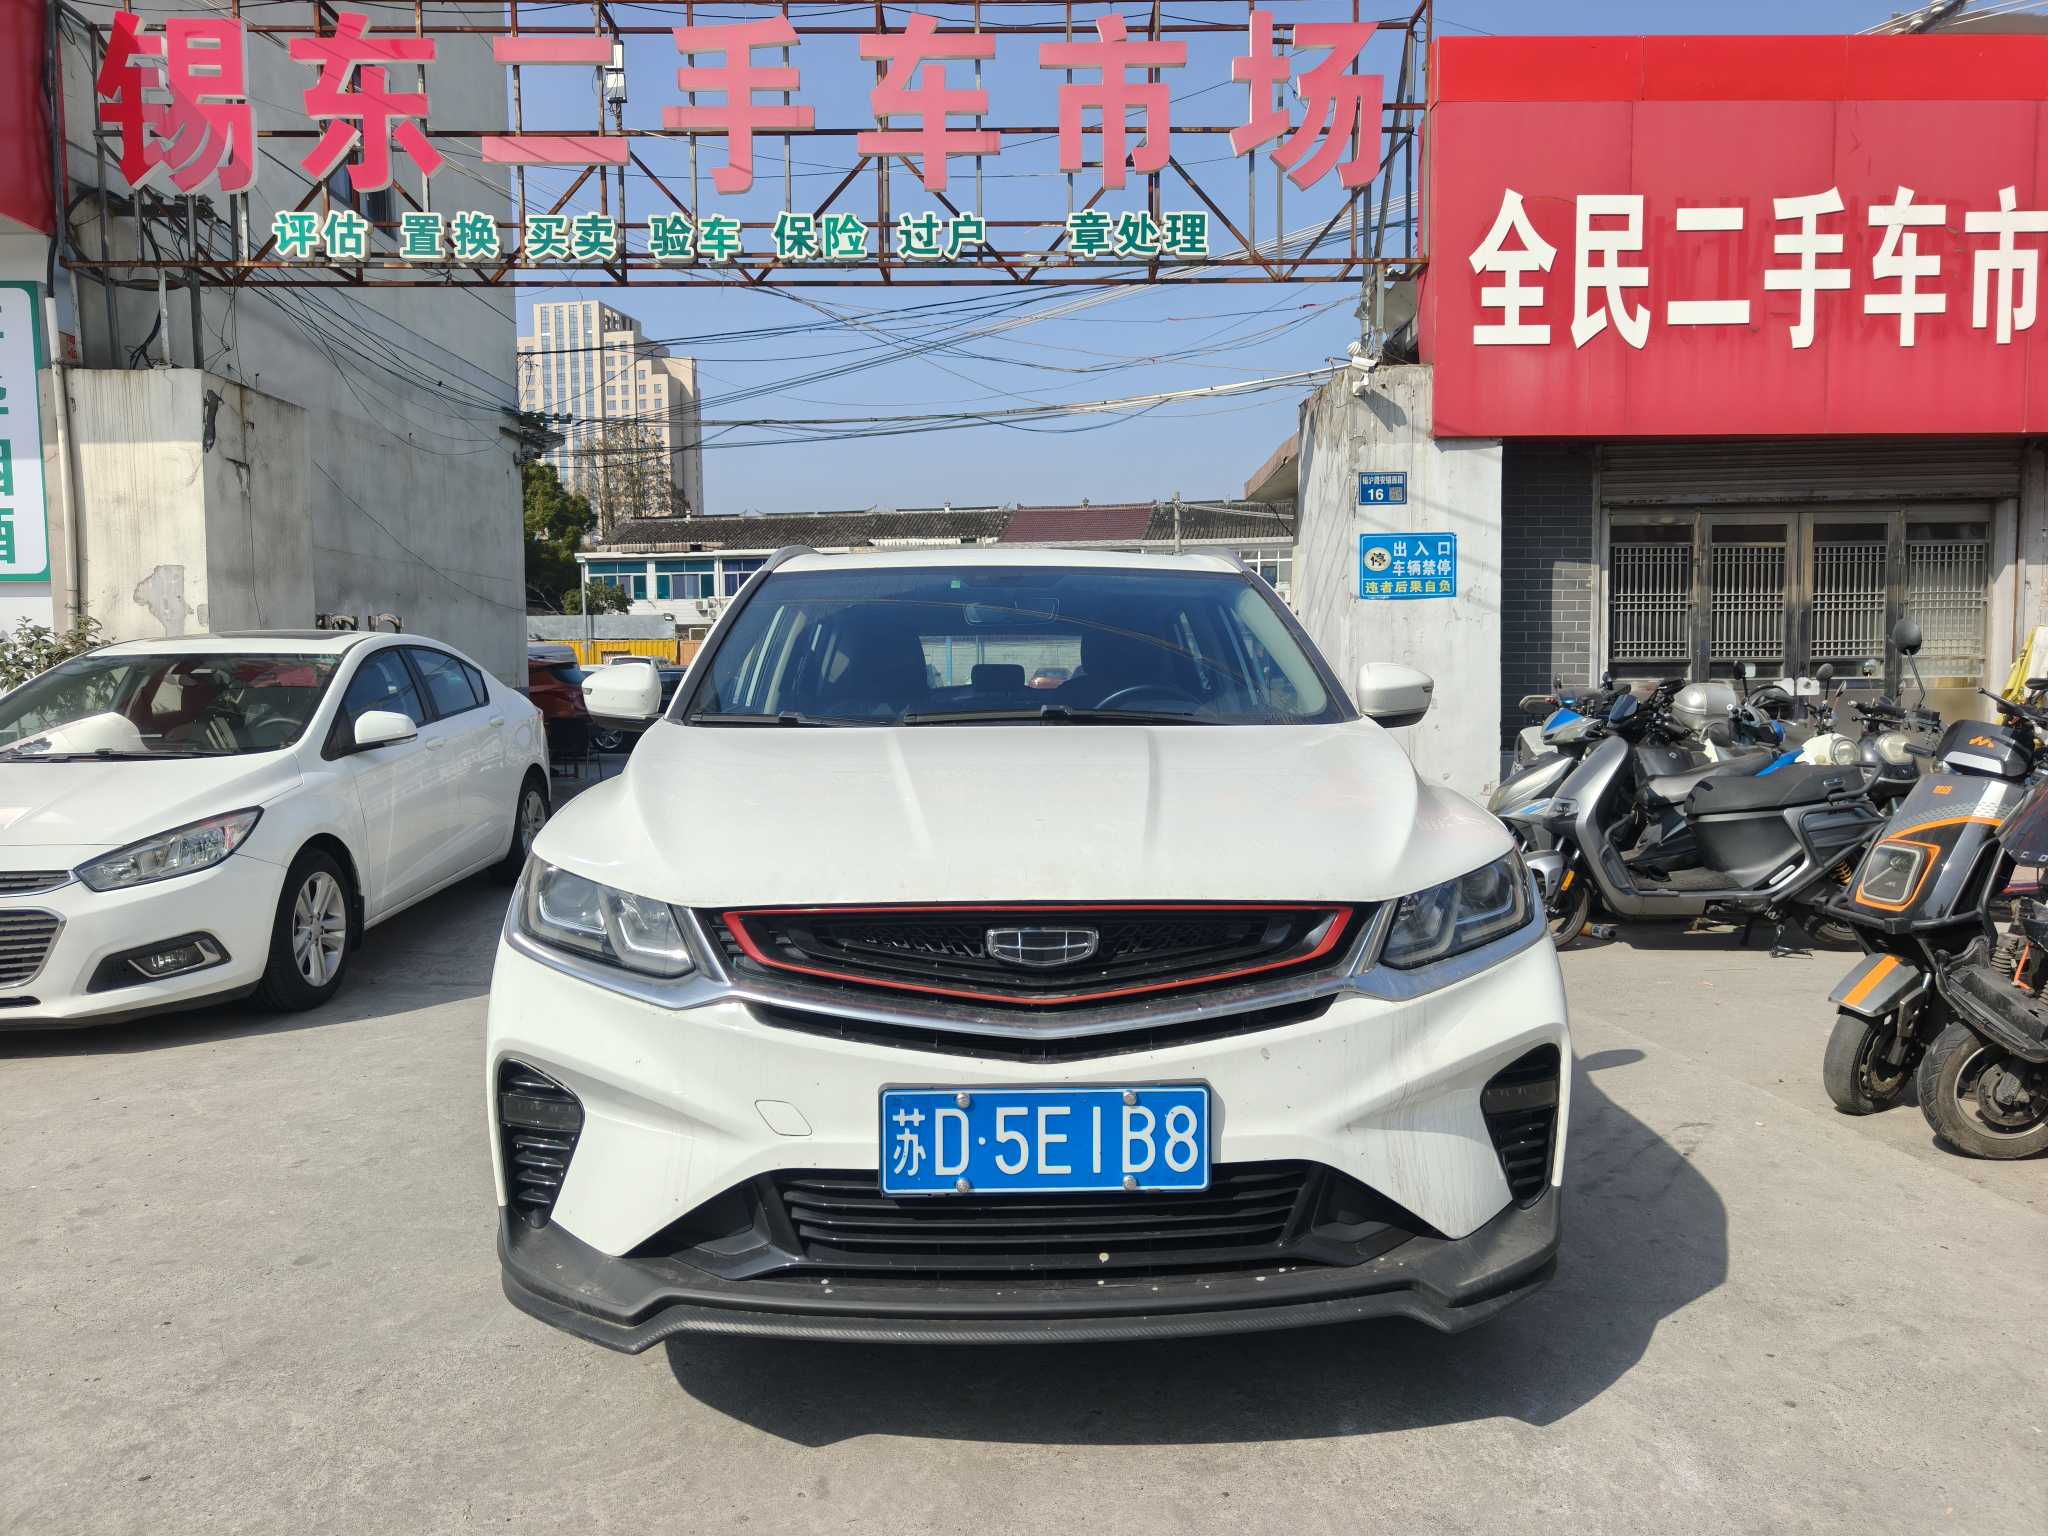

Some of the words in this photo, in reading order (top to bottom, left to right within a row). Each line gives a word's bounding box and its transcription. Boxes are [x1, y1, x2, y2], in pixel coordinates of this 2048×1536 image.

[97, 11, 1385, 193] 锡东二手车市场
[273, 212, 366, 257] 评估
[402, 213, 498, 258] 置换
[527, 213, 614, 258] 买卖
[648, 214, 738, 259] 验车
[773, 212, 866, 258] 保险
[899, 212, 984, 256] 过户
[1069, 211, 1207, 255] 章处理
[1468, 185, 2048, 350] 全民二手车市
[1367, 488, 1384, 501] 16
[1393, 541, 1450, 557] 出入口
[1392, 559, 1452, 576] 车辆禁停
[1365, 579, 1451, 594] 违者后果自负
